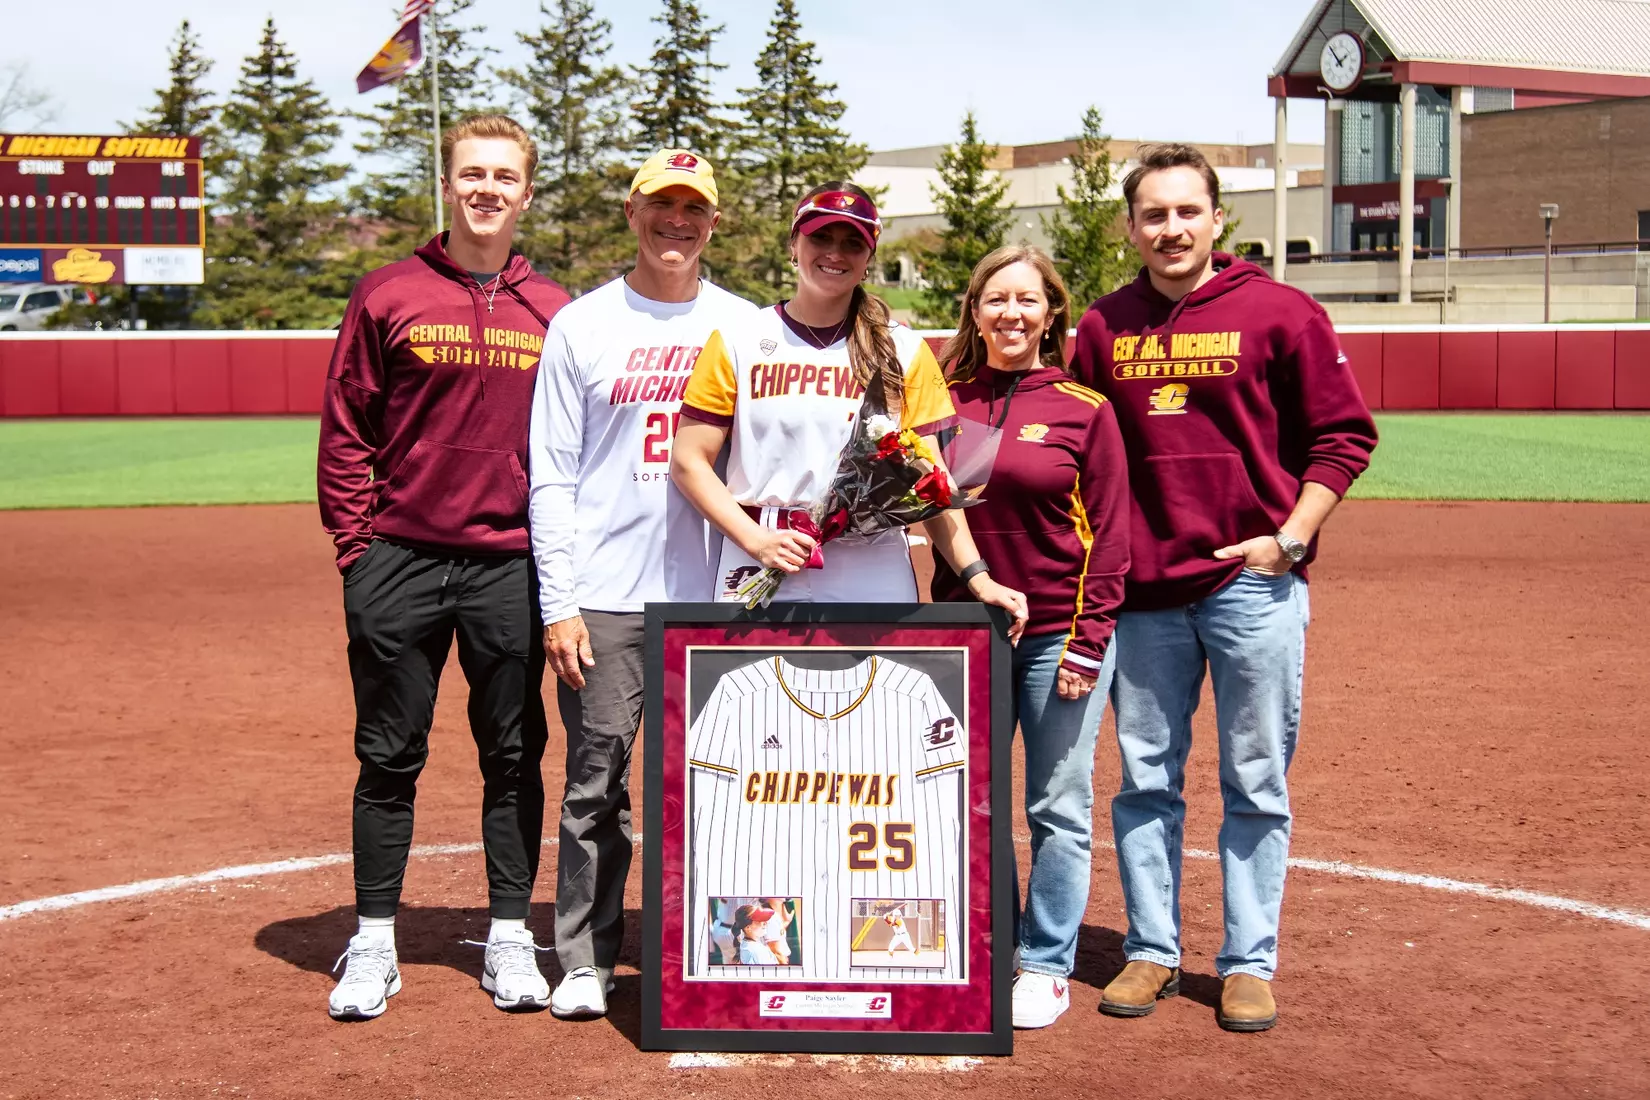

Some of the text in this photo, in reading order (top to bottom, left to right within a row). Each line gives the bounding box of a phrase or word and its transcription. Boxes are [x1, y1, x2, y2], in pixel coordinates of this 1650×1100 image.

[7, 136, 102, 156] MICHIGAN
[102, 137, 189, 158] SOFTBALL
[87, 160, 116, 175] OUT
[409, 324, 472, 343] CENTRAL
[1170, 331, 1241, 359] MICHIGAN
[1121, 361, 1225, 378] SOFTBALL
[643, 412, 680, 463] 2
[746, 771, 898, 807] CHIPPEWAS
[848, 821, 916, 872] 25
